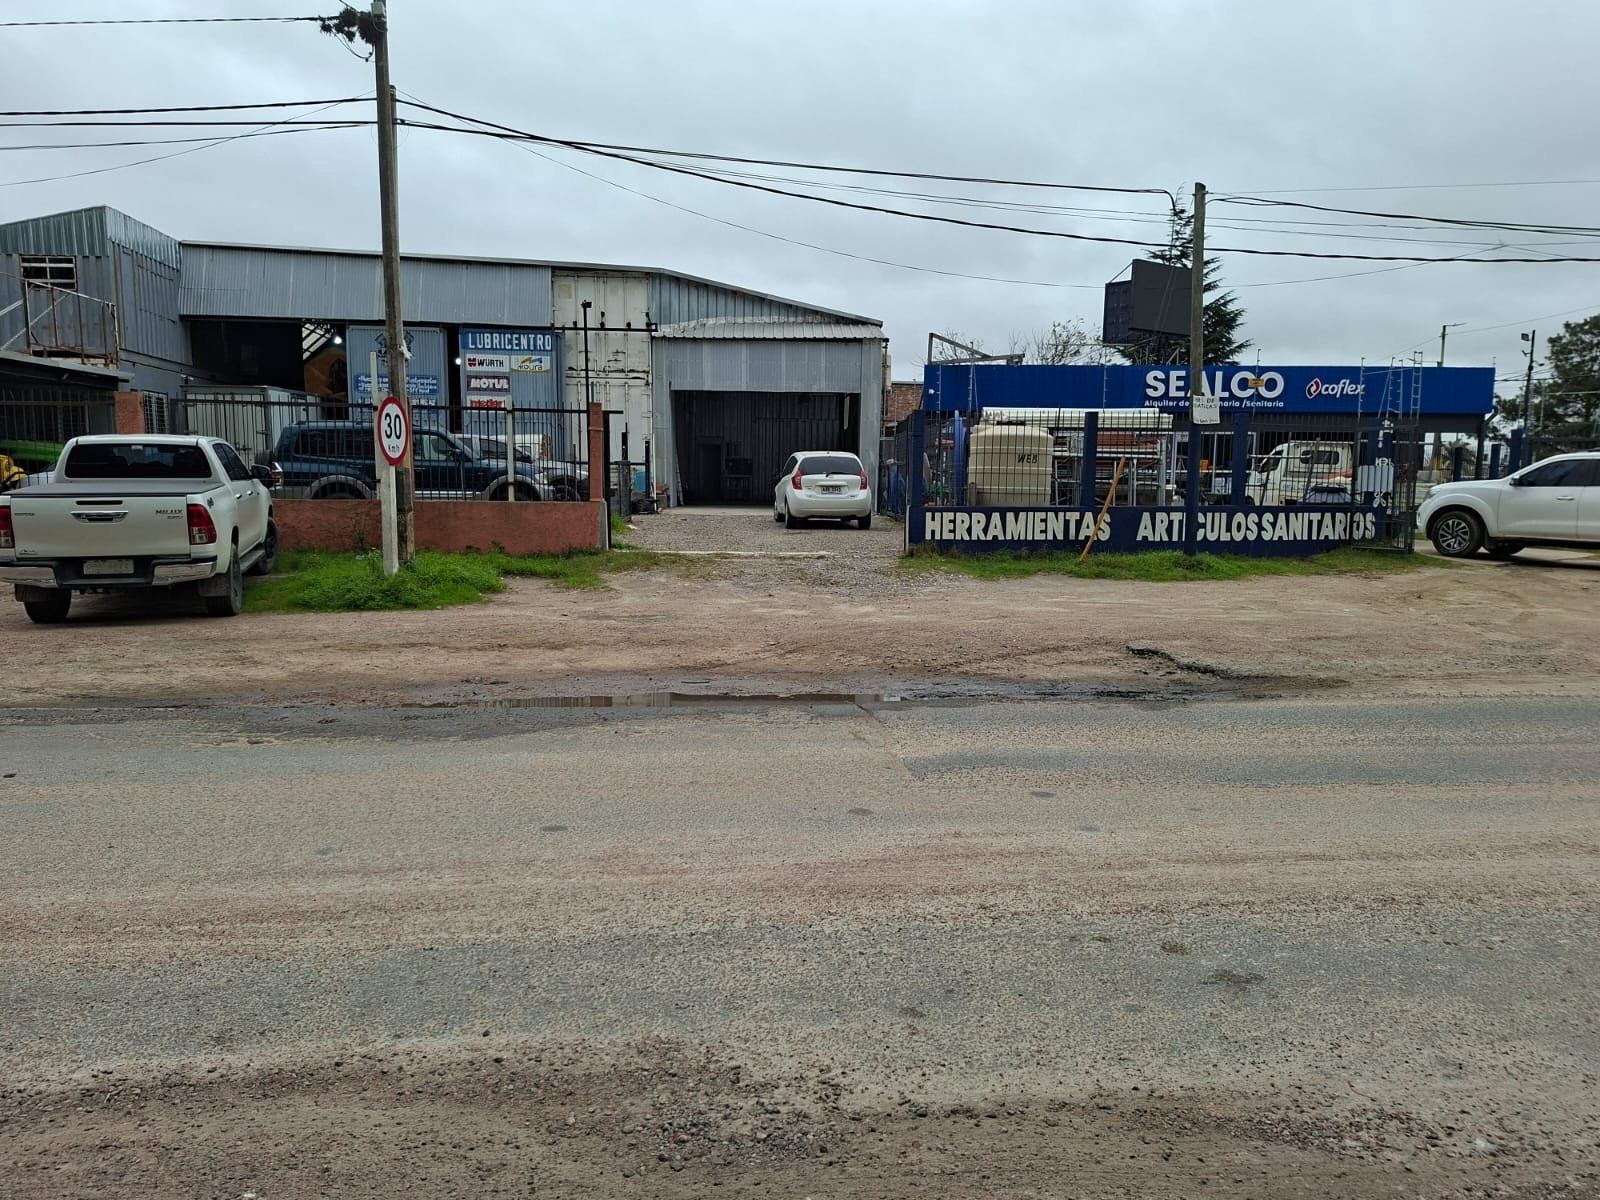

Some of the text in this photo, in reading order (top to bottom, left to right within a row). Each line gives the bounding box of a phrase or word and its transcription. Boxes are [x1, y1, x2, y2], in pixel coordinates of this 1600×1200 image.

[468, 333, 552, 350] LUBRICENTRO
[470, 378, 509, 389] MOTUL
[1145, 370, 1285, 399] SEALCO
[1321, 379, 1366, 398] coflex
[1144, 399, 1177, 408] Alquiler
[1179, 399, 1190, 407] de
[385, 412, 402, 440] 30
[925, 511, 1111, 542] HERRAMIENTAS
